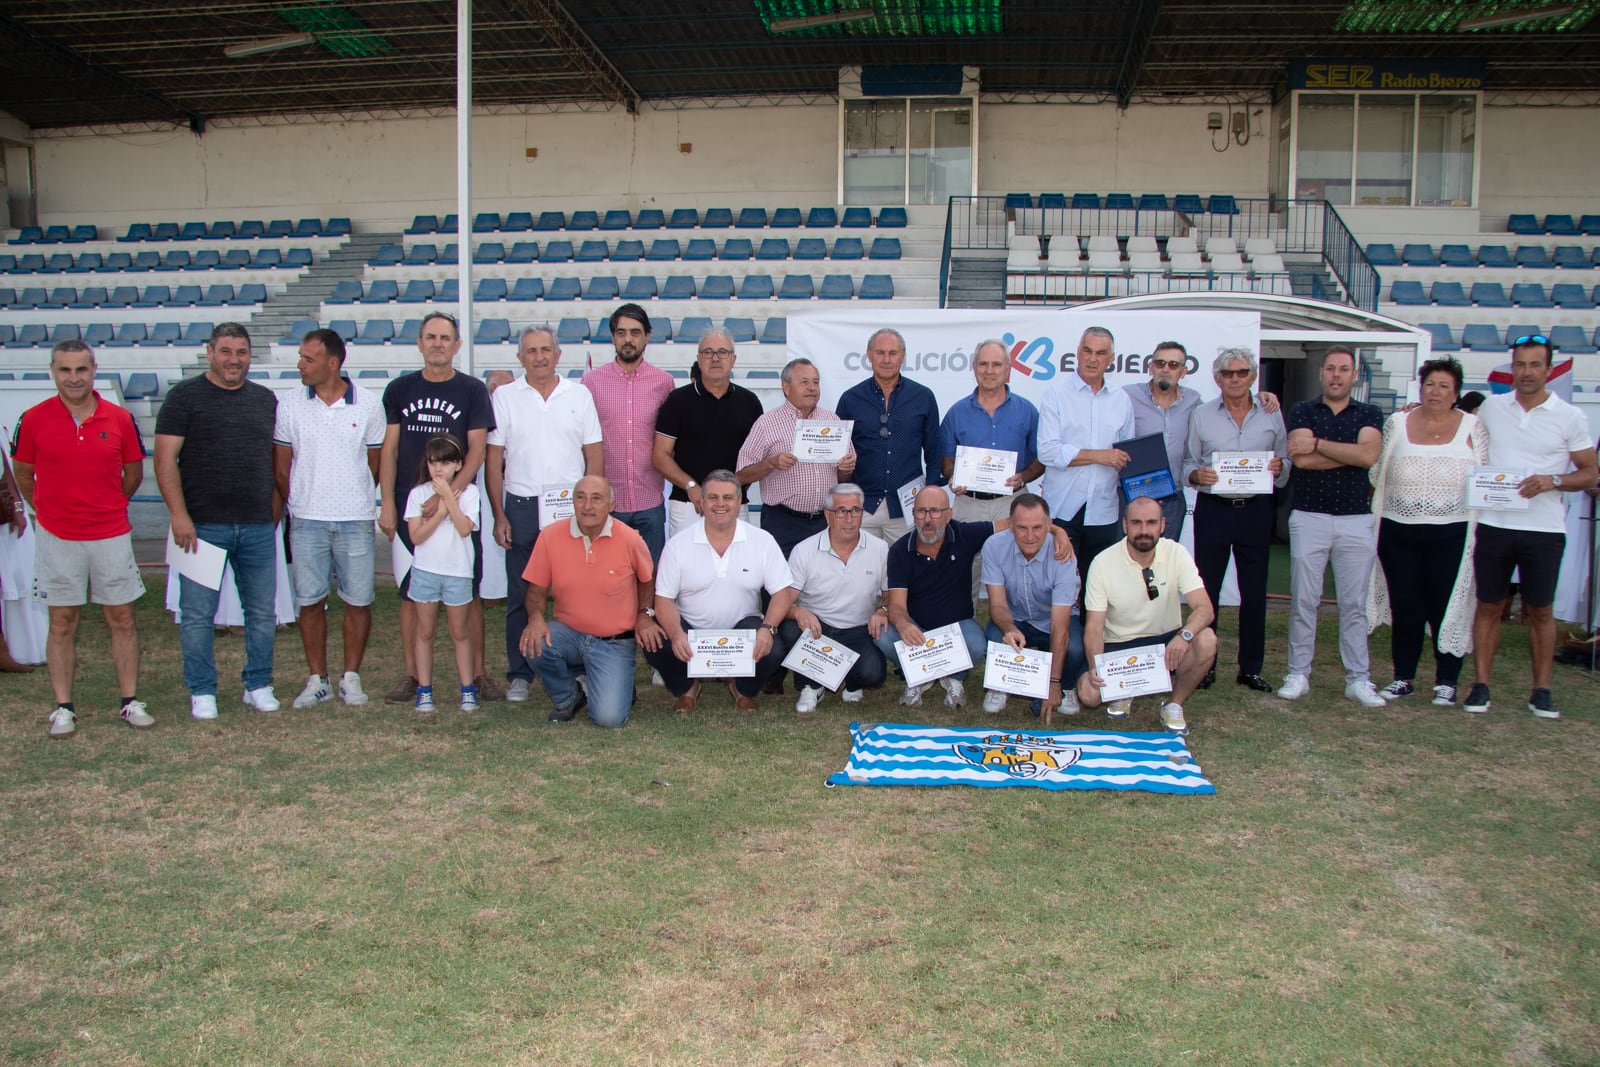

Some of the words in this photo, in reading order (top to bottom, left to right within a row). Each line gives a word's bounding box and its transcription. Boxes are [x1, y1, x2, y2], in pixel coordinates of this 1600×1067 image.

[1305, 64, 1373, 87] SER
[1380, 71, 1427, 88] Radio
[1429, 72, 1481, 88] Bierzo
[843, 348, 975, 371] CLICIÓ
[402, 397, 462, 421] PASADENA
[417, 413, 442, 423] MMXVIII
